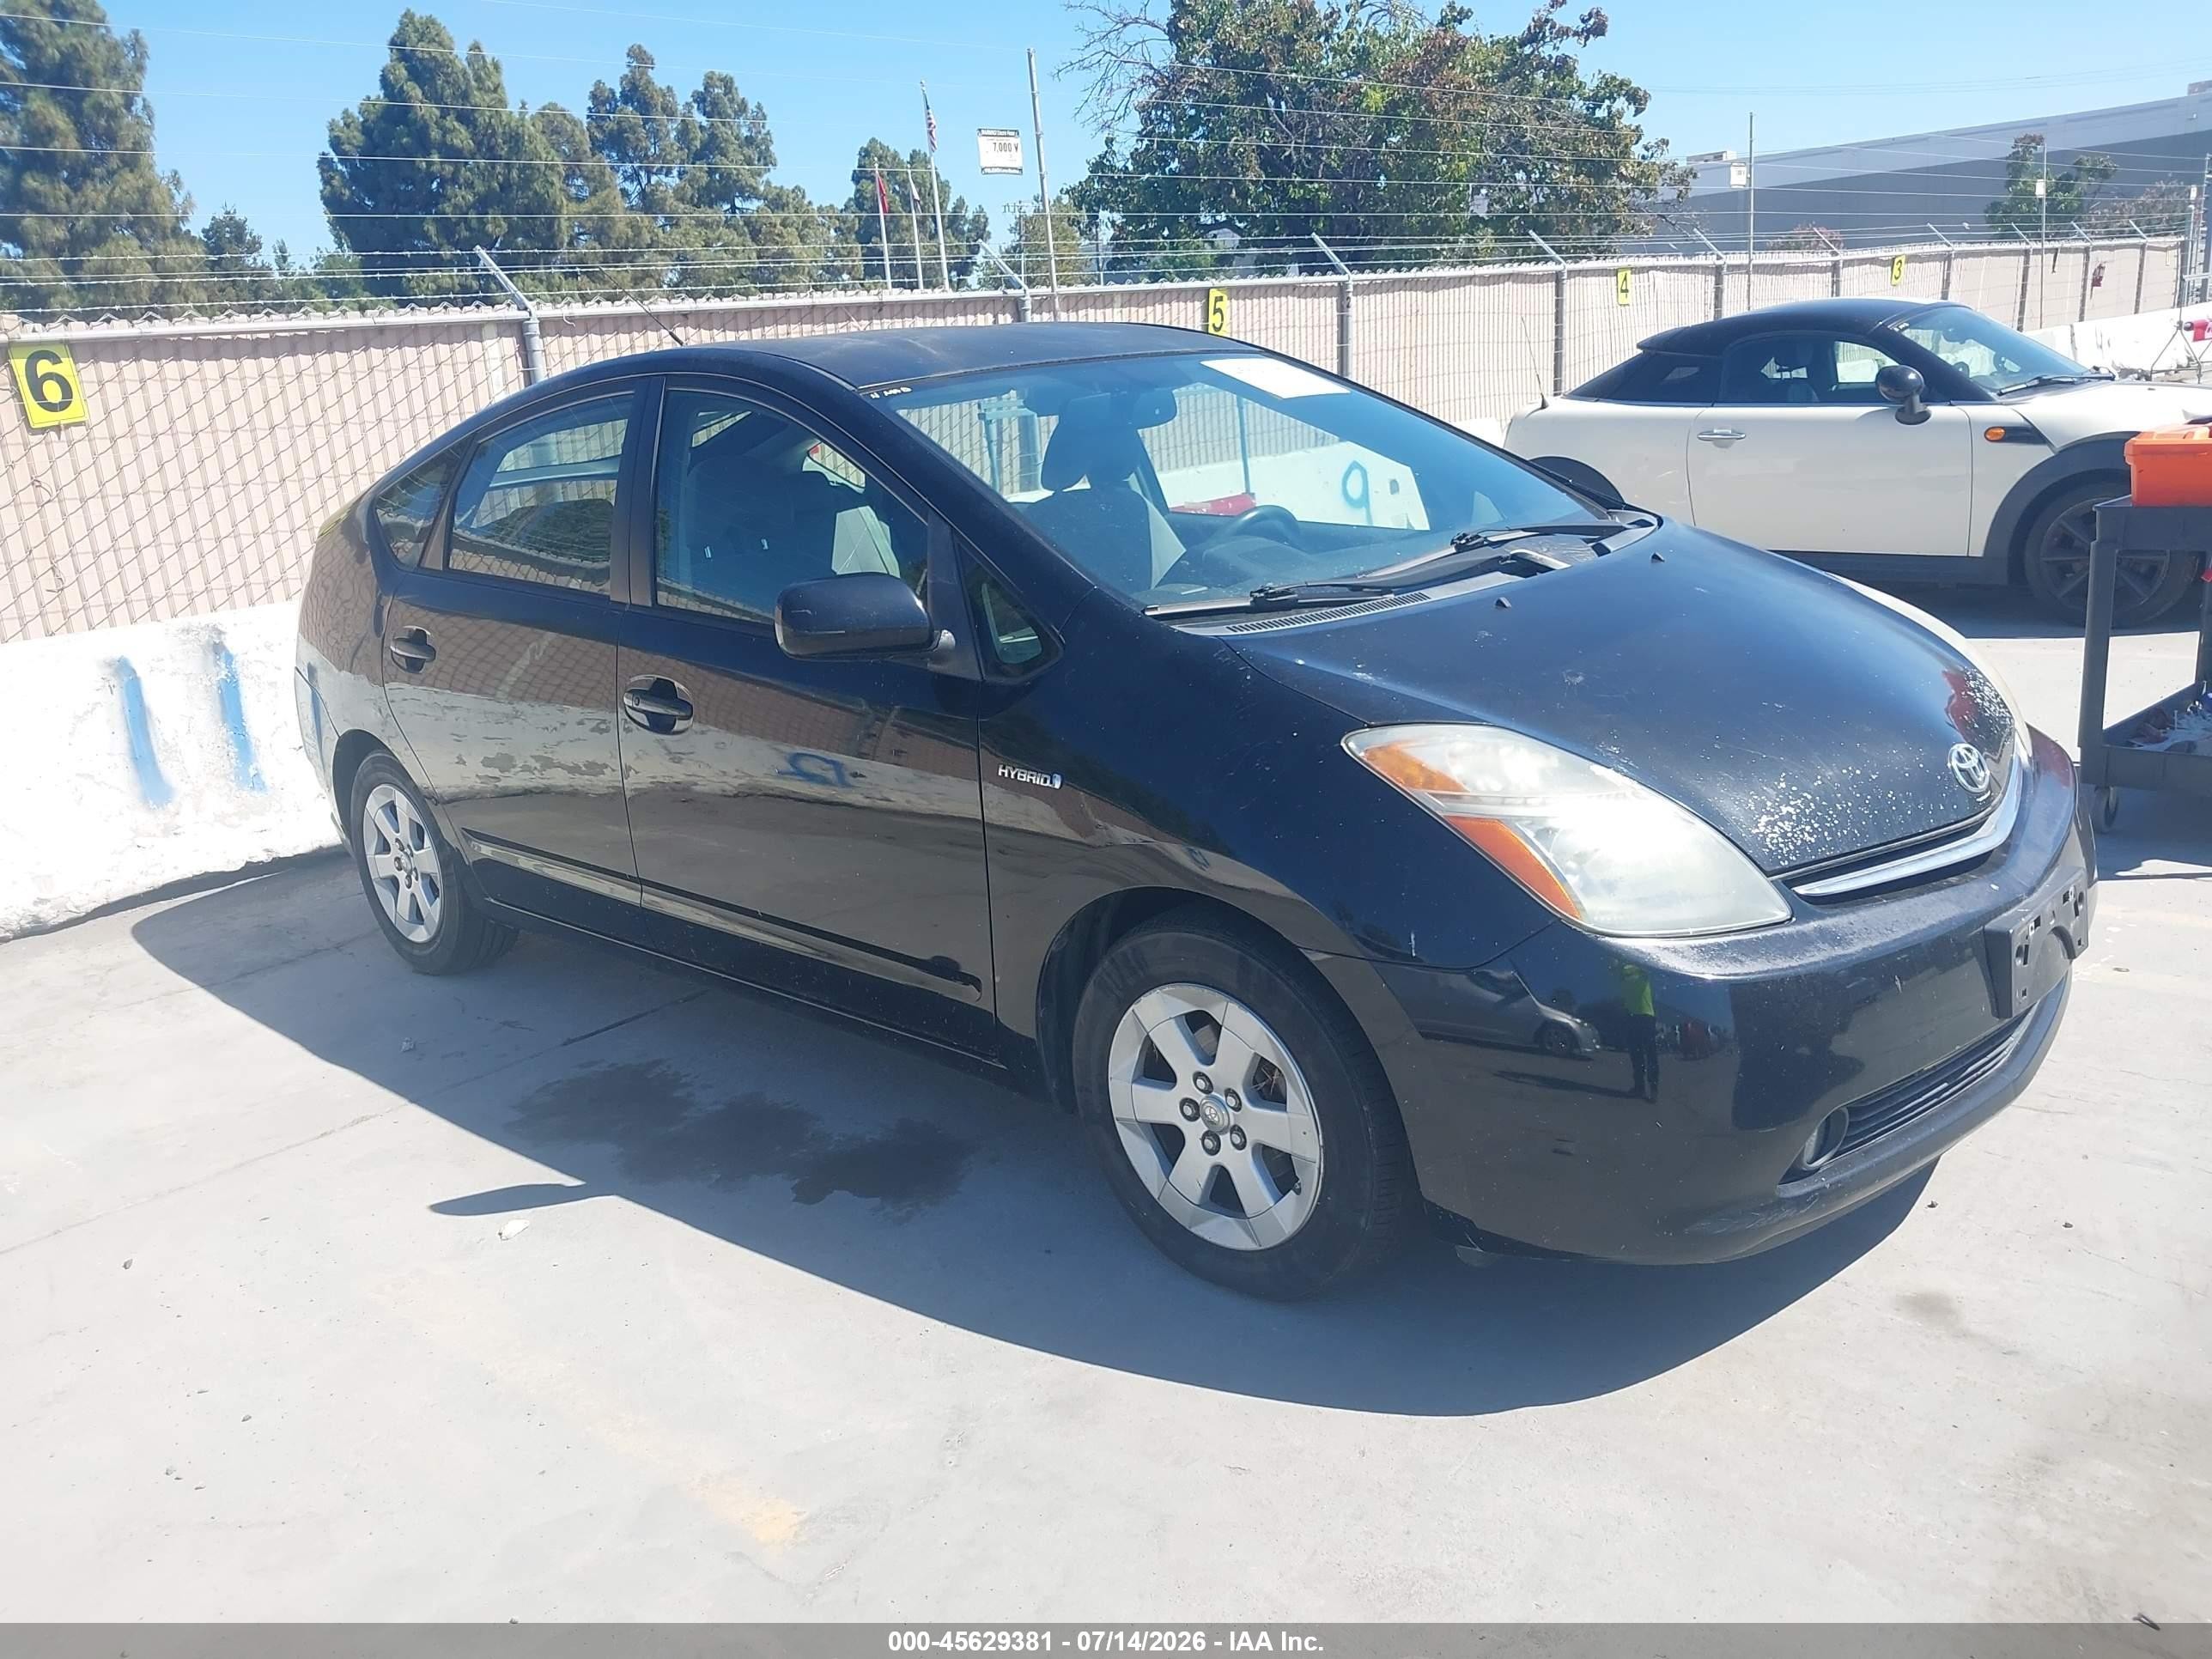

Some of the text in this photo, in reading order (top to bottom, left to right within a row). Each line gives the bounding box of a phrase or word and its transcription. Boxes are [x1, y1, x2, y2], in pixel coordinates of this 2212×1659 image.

[993, 142, 1012, 153] 7,000
[1894, 259, 1902, 281] 3
[1620, 272, 1629, 299] 4
[1212, 295, 1224, 332] 5
[25, 349, 73, 412] 6
[999, 764, 1051, 787] HYBRID
